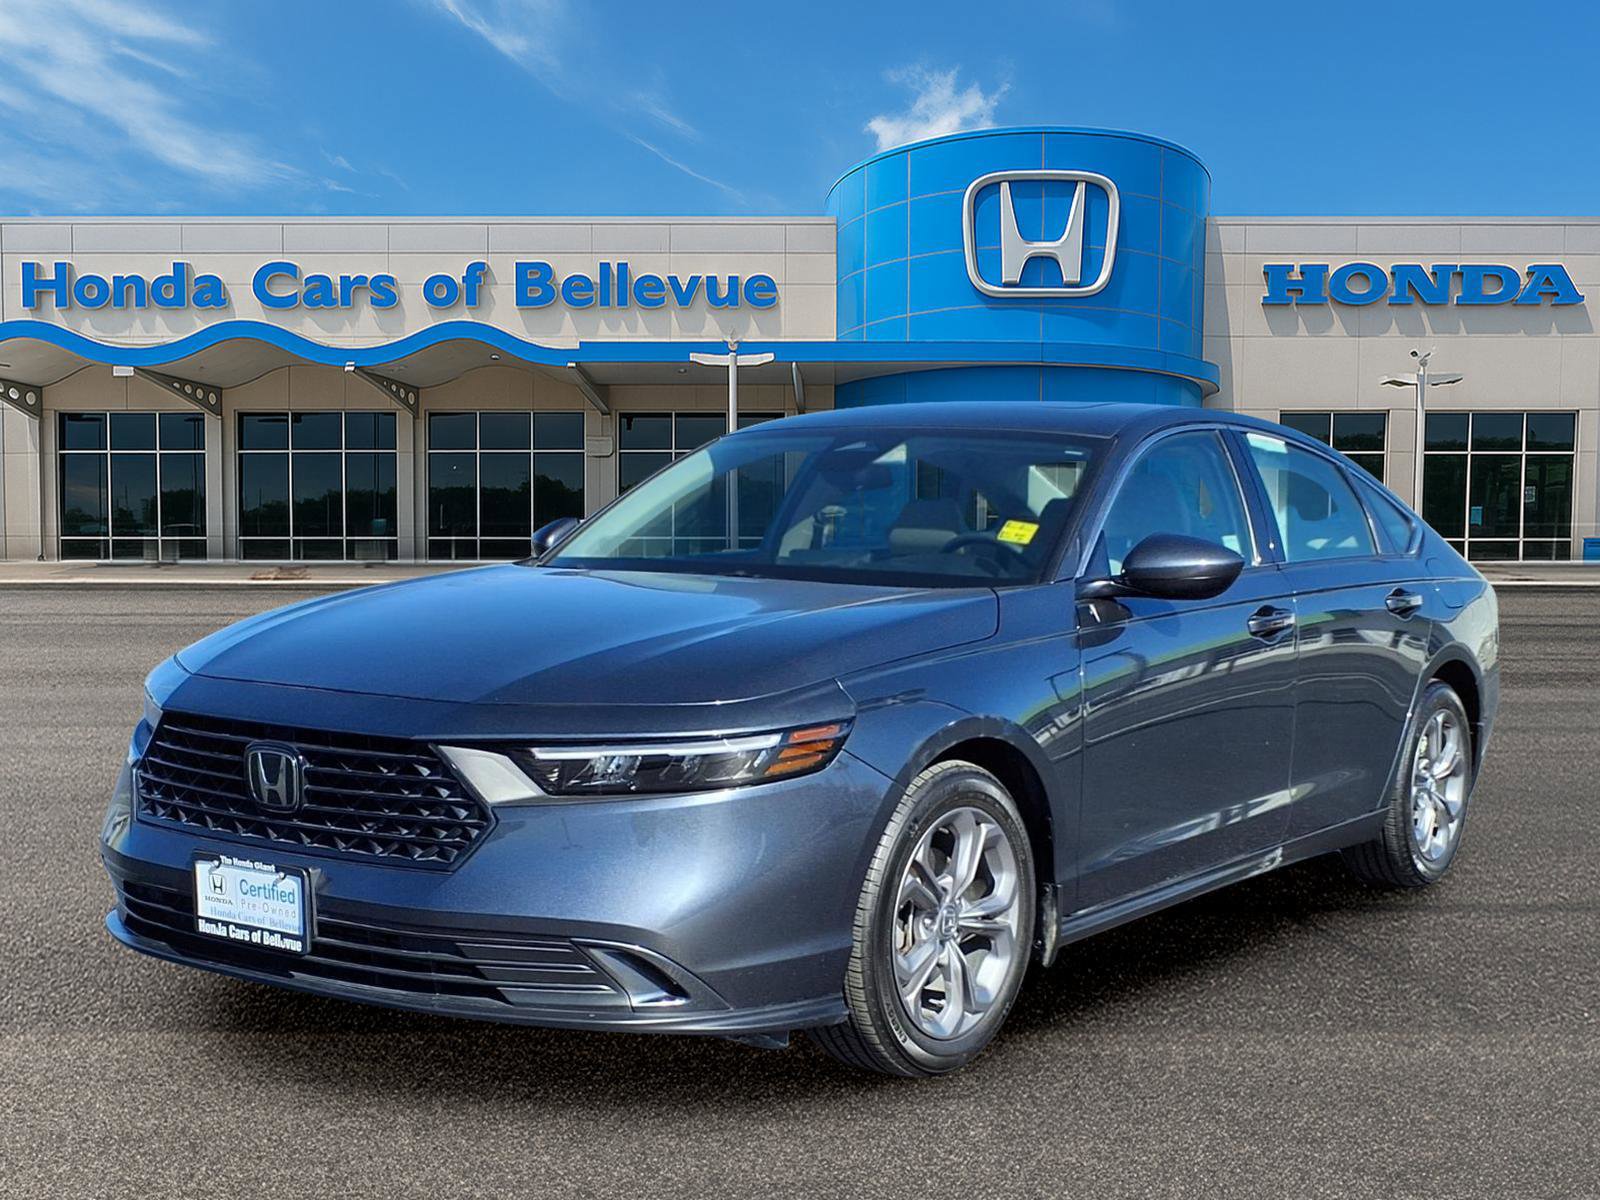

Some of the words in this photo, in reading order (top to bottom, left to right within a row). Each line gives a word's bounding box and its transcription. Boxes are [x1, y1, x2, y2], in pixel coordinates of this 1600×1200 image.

[20, 261, 228, 309] Honda
[252, 261, 399, 309] Cars
[422, 261, 489, 308] of
[514, 261, 779, 309] Bellevue
[1261, 262, 1585, 306] HONDA
[232, 857, 254, 868] Honda
[205, 895, 233, 906] HONDA
[239, 879, 296, 904] Certified
[198, 919, 228, 936] Honda
[228, 923, 250, 942] Cars
[251, 930, 262, 943] of
[262, 929, 302, 952] Bellevue
